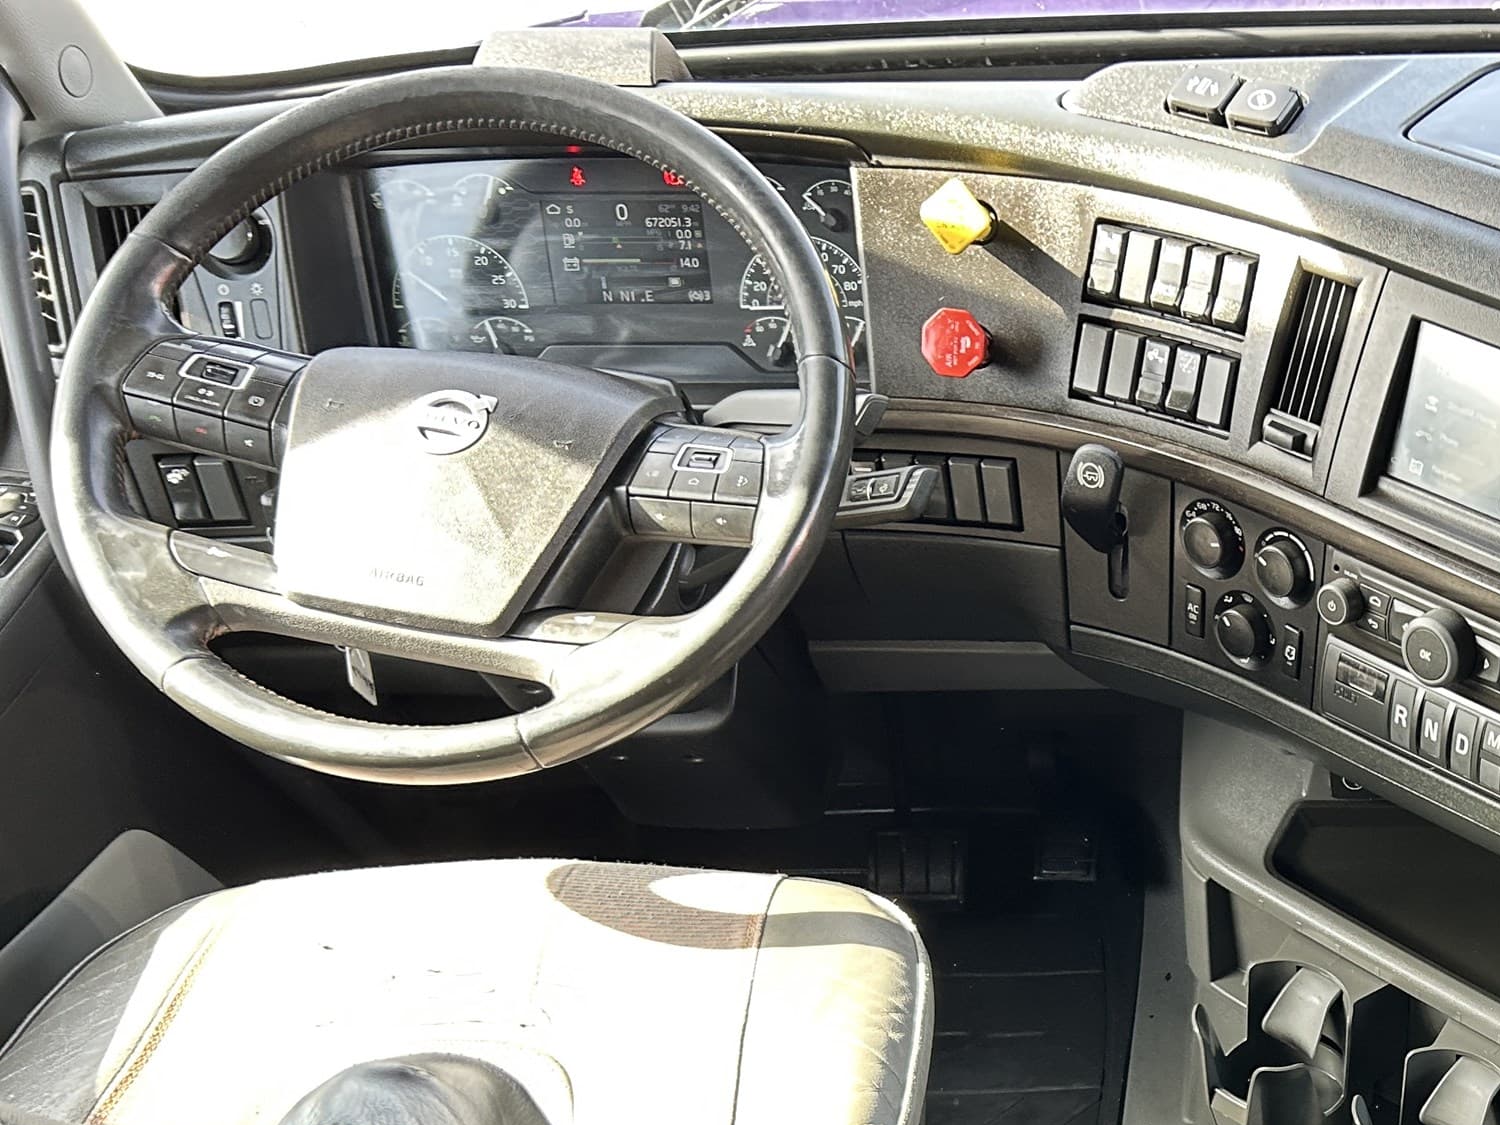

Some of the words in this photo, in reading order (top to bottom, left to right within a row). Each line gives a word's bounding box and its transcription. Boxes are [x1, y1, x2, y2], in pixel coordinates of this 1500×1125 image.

[566, 205, 574, 214] S
[615, 203, 629, 221] 0
[645, 217, 692, 228] 672051.3
[675, 229, 692, 239] 0.0
[679, 240, 692, 250] 7.1
[474, 255, 488, 266] 20
[679, 257, 700, 268] 14.0
[831, 264, 846, 275] 70
[491, 274, 506, 285] 25
[752, 281, 767, 292] 20
[843, 281, 858, 291] 80
[503, 299, 517, 309] 30
[1187, 602, 1199, 614] AC
[1419, 648, 1432, 661] OK
[1394, 703, 1408, 728] R
[1424, 718, 1439, 742] N
[1455, 732, 1469, 755] D
